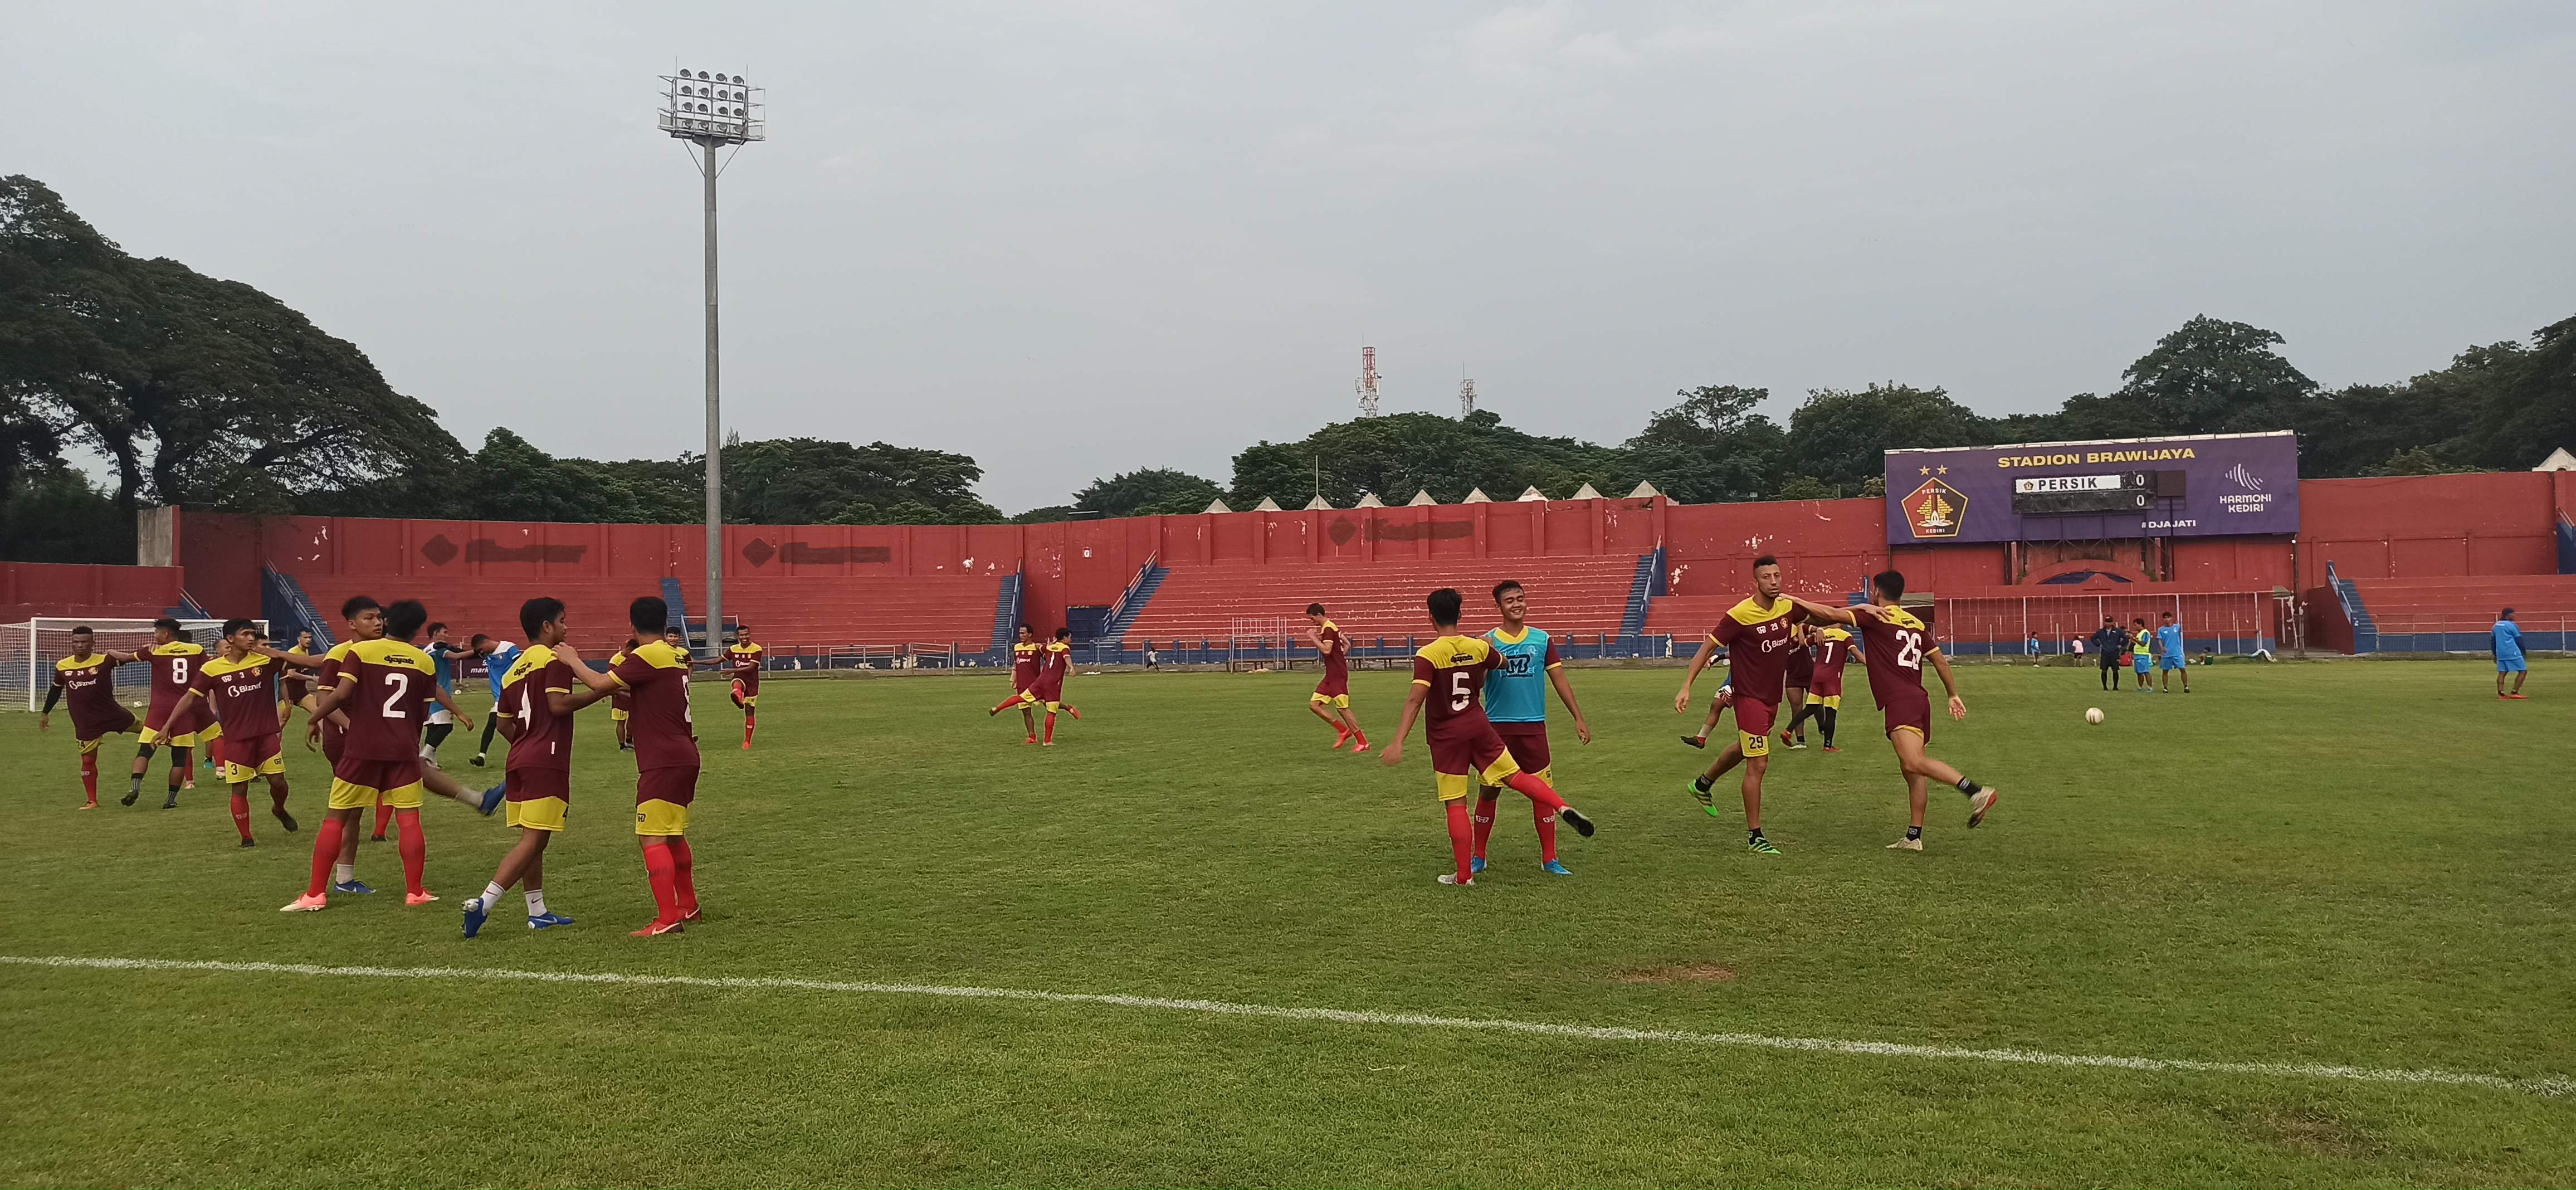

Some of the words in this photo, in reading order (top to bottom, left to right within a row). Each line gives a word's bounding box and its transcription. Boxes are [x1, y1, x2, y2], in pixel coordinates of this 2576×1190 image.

[1998, 453, 2080, 468] STADION
[2087, 448, 2196, 464] BRAWIJAYA
[2038, 477, 2098, 490] PERSIK
[2136, 475, 2144, 486] 0
[2136, 495, 2144, 506] 0
[2219, 494, 2271, 504] HARMONI
[2228, 504, 2263, 513] KEDIRI
[1770, 622, 1778, 631] 29
[1824, 642, 1833, 664] 7
[1895, 630, 1921, 671] 26
[173, 658, 188, 684] 8
[383, 673, 408, 718] 2
[1451, 672, 1471, 711] 5
[1749, 736, 1763, 749] 29
[231, 764, 237, 775] 3
